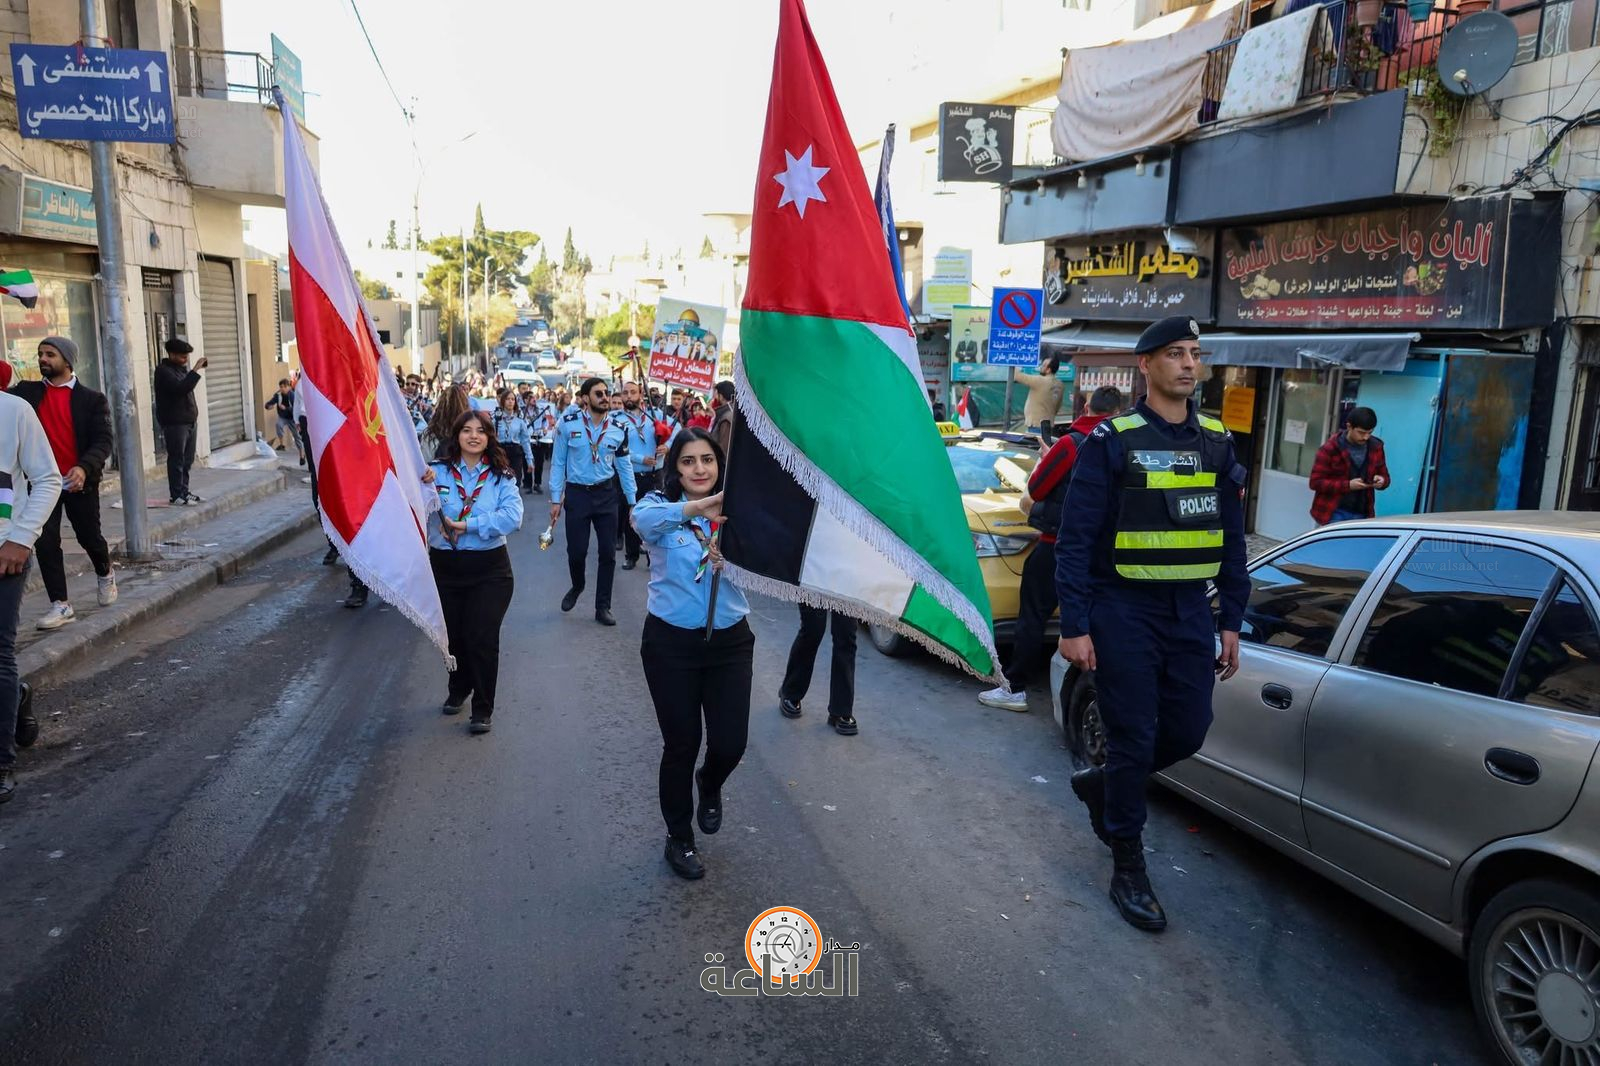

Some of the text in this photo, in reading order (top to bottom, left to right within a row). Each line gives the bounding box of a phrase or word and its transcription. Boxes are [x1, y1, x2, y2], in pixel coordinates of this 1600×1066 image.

[42, 53, 140, 84] مستشفى
[26, 93, 119, 136] التخصصي
[122, 95, 166, 132] ماركا
[974, 151, 990, 164] SH
[1280, 225, 1337, 264] جرش
[1429, 217, 1493, 270] ألبان
[1064, 240, 1199, 285] مطعم الشخشير
[1314, 278, 1340, 293] الوليد
[1341, 275, 1363, 292] ألبان
[1365, 275, 1398, 291] منتجات
[1120, 287, 1138, 307] فلافل
[1144, 287, 1157, 308] فول
[1163, 292, 1185, 308] حمص
[1383, 304, 1402, 319] جبنة
[1415, 304, 1434, 318] لبنة
[1446, 304, 1463, 318] لبن
[653, 356, 712, 375] فلسطين والقدس
[1132, 452, 1198, 471] الشرطة
[1179, 495, 1217, 515] POLICE
